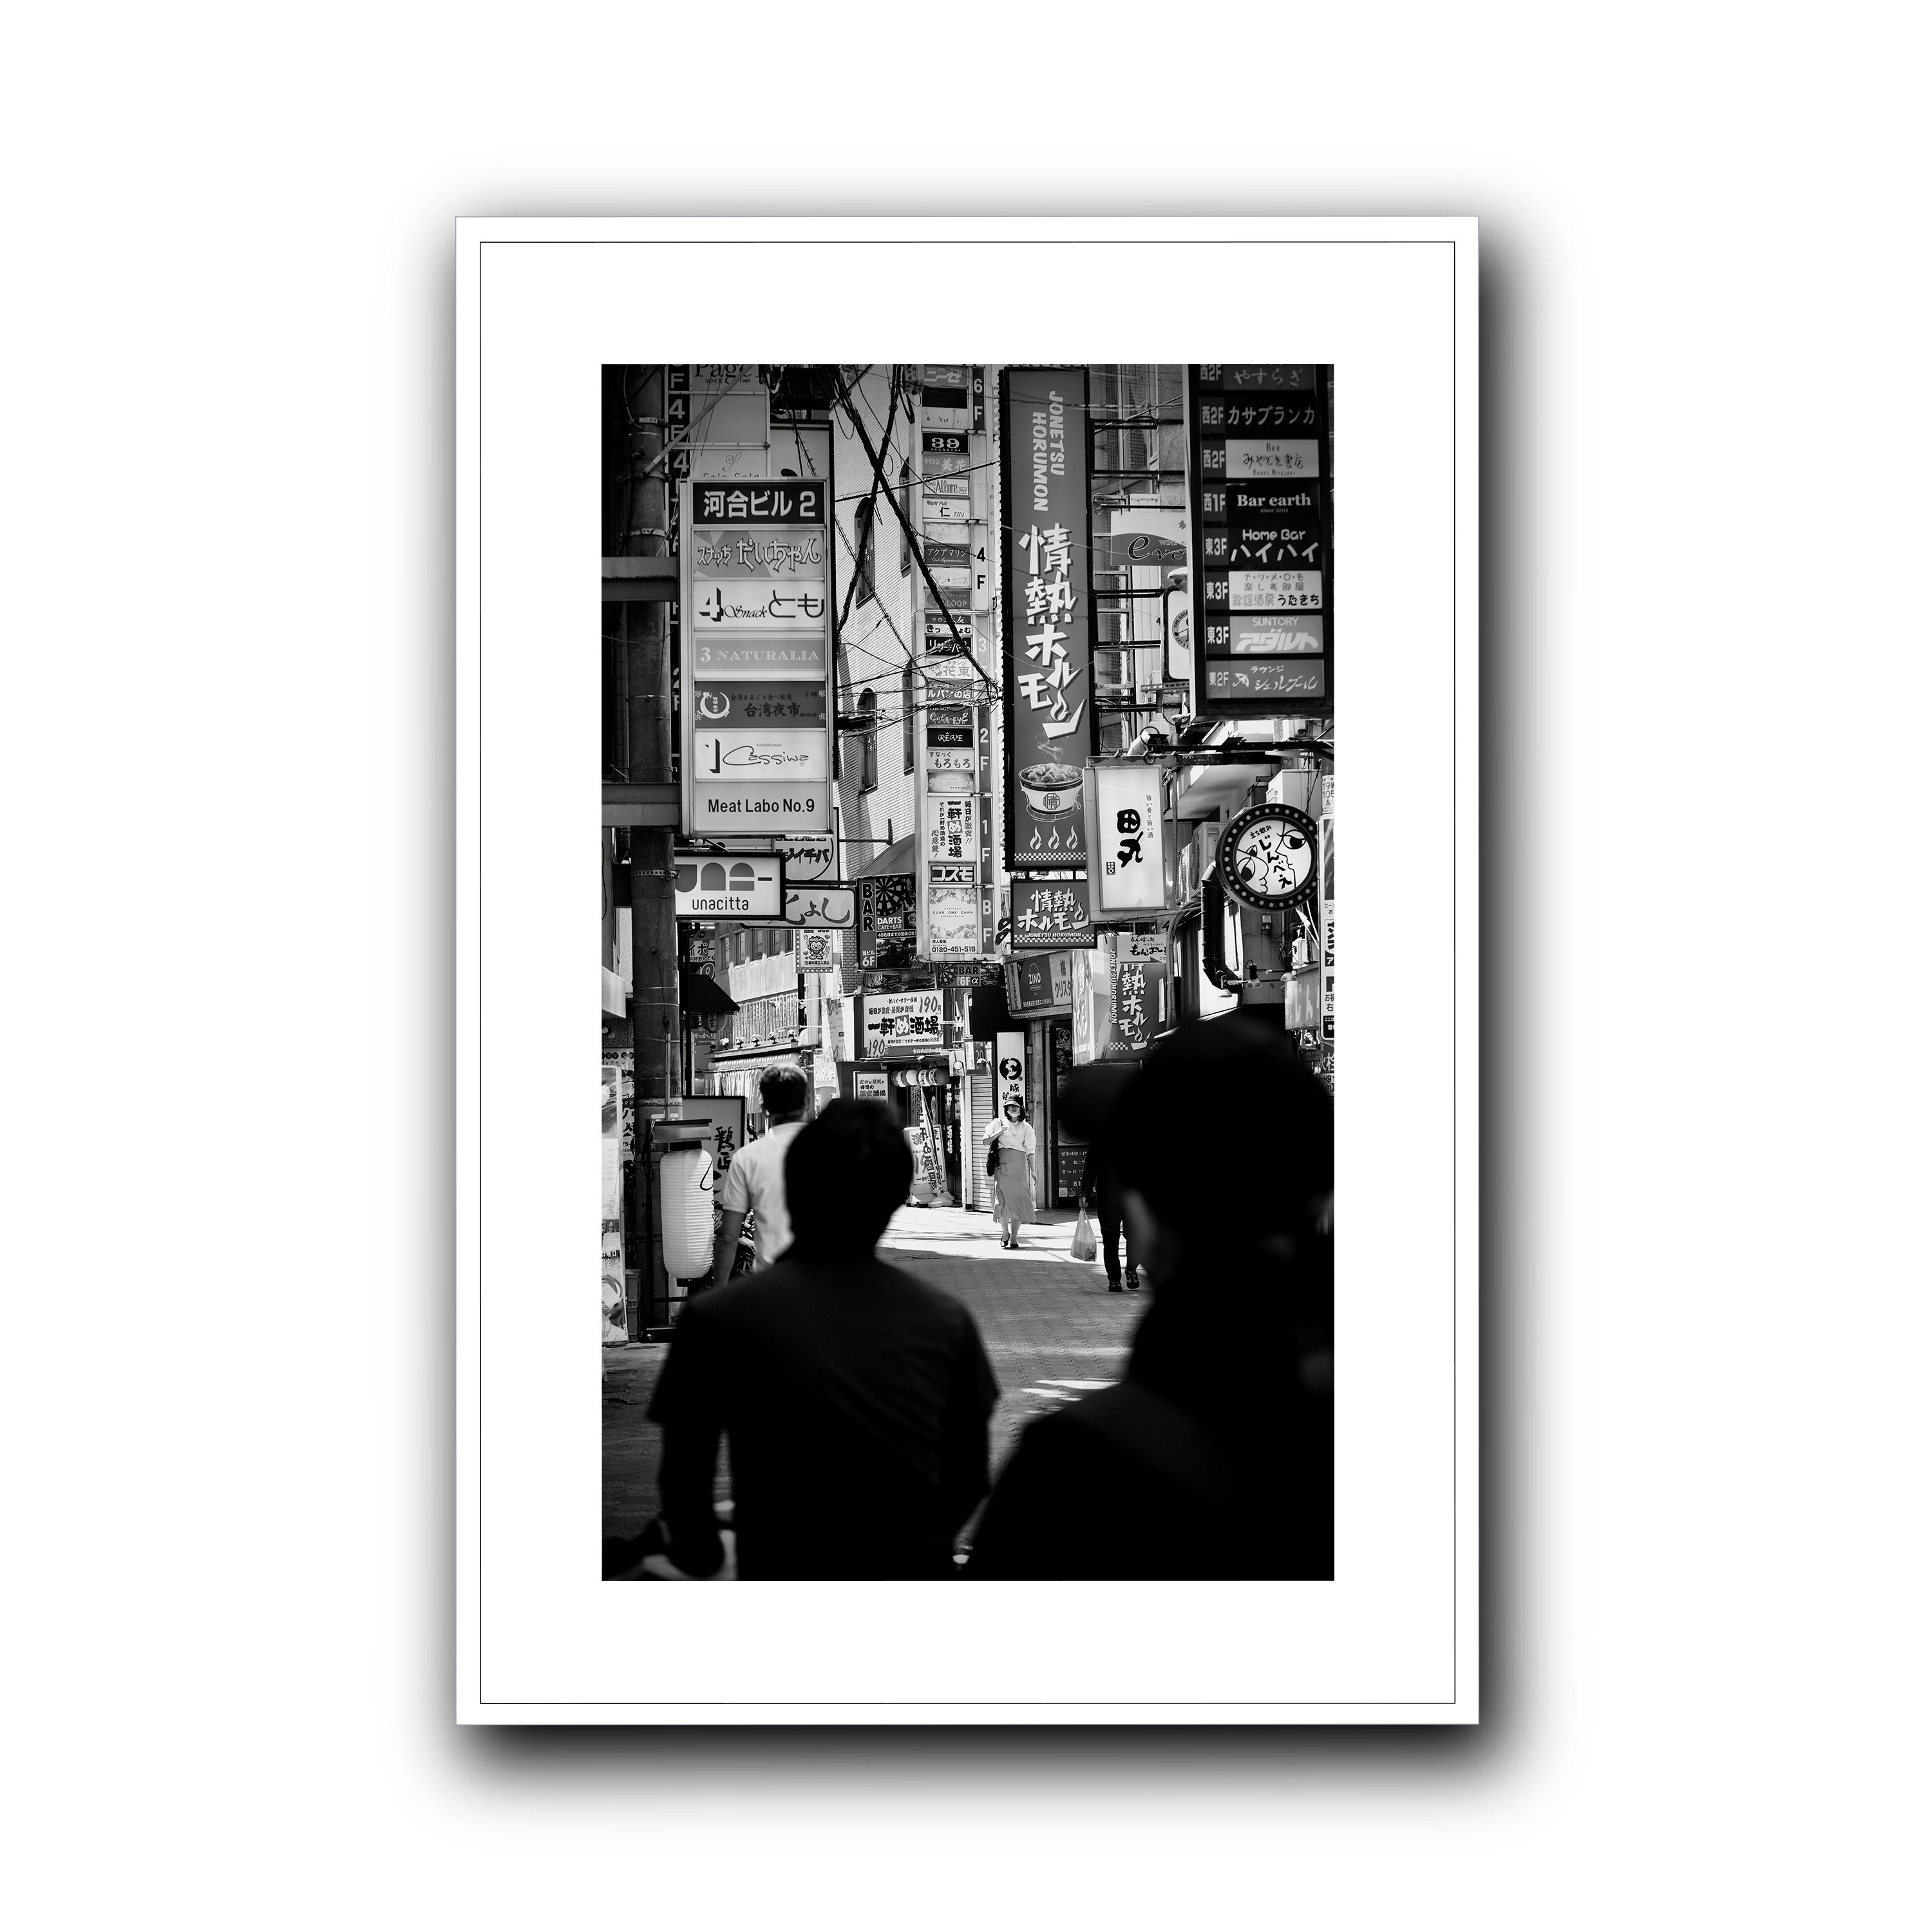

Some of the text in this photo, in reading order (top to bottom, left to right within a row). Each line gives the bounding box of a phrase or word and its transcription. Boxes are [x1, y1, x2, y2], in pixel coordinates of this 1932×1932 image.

[1202, 405, 1315, 426] 西2F カサブランカ
[1049, 390, 1065, 476] JONETSU
[931, 437, 960, 449] 39
[1032, 412, 1048, 511] HORUMON
[1203, 450, 1225, 469] 西2F
[934, 480, 958, 494] Allure
[703, 490, 815, 517] 河合ビル 2
[940, 506, 950, 517] 仁
[1204, 493, 1311, 512] 西1F Bar earth
[1128, 535, 1188, 560] eve
[1205, 528, 1306, 556] 東3F Home Bar
[736, 538, 822, 573] だいちゃん
[927, 548, 967, 557] アクアマリン
[1230, 542, 1319, 564] ハイハイ
[1206, 581, 1228, 600] 東3F
[1278, 594, 1319, 606] うたきち
[699, 587, 824, 621] 4 Snack とも
[926, 624, 971, 634] きっょむ
[1018, 522, 1087, 741] 情熱ホルモン
[1207, 616, 1300, 644] 東3F SUNTORY
[700, 647, 820, 662] 3 NATURALIA
[1209, 665, 1285, 687] 東2F ラウンジ
[744, 703, 800, 717] 台湾夜市
[934, 758, 971, 768] もろもろ
[708, 799, 815, 812] Meat Labo No.9
[947, 800, 963, 858] 一軒め酒場
[1249, 825, 1272, 839] 立ち飲み
[1258, 835, 1293, 889] じんべえ
[931, 866, 973, 882] コスモ
[692, 896, 749, 911] unacitta
[862, 882, 875, 933] BAR
[1030, 888, 1076, 913] 情熱
[877, 916, 902, 925] DARTS
[1017, 907, 1090, 932] ホルモン
[862, 956, 875, 967] 6F
[958, 965, 980, 974] BAR
[960, 976, 970, 986] 6F
[1028, 972, 1041, 985] ZINO
[1110, 983, 1119, 1025] HORUMON
[867, 1014, 939, 1037] 一軒め酒場
